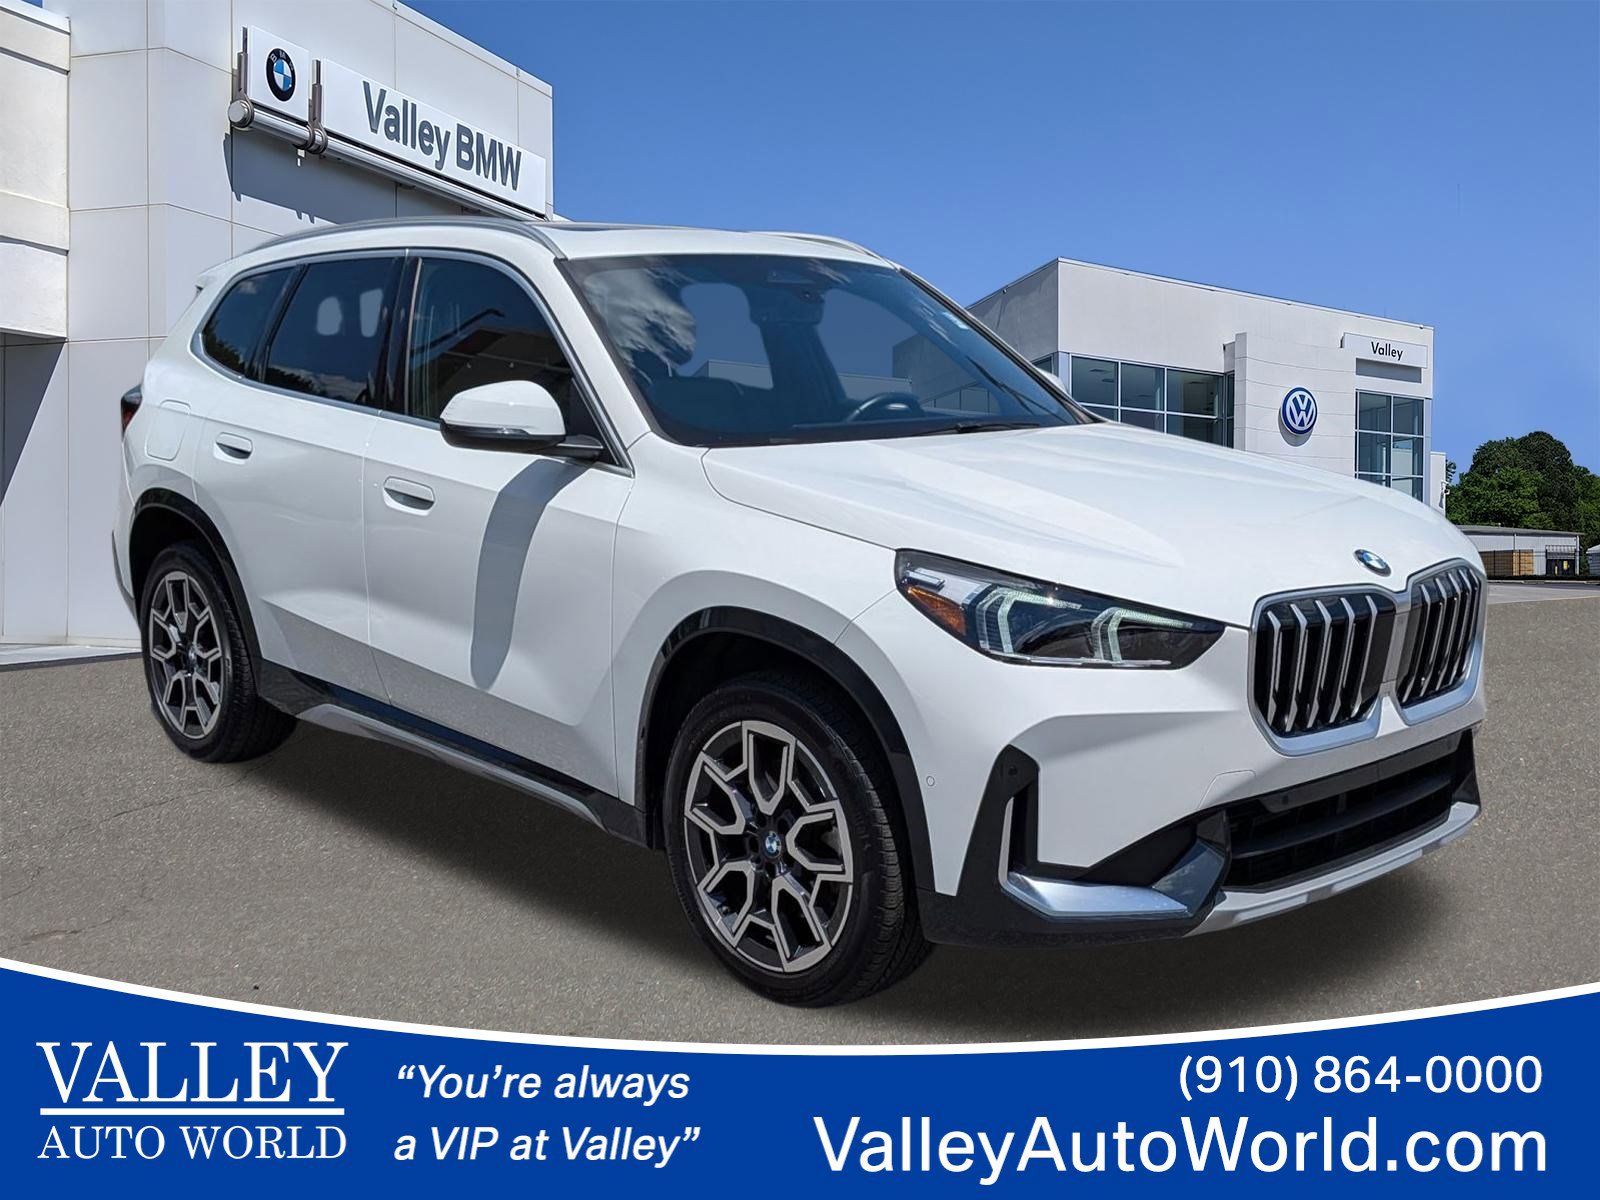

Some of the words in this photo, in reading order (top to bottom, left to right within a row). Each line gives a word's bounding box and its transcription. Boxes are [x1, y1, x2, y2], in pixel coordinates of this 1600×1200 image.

[362, 80, 451, 171] Valley
[456, 123, 522, 191] BMW
[1371, 341, 1403, 361] Valley
